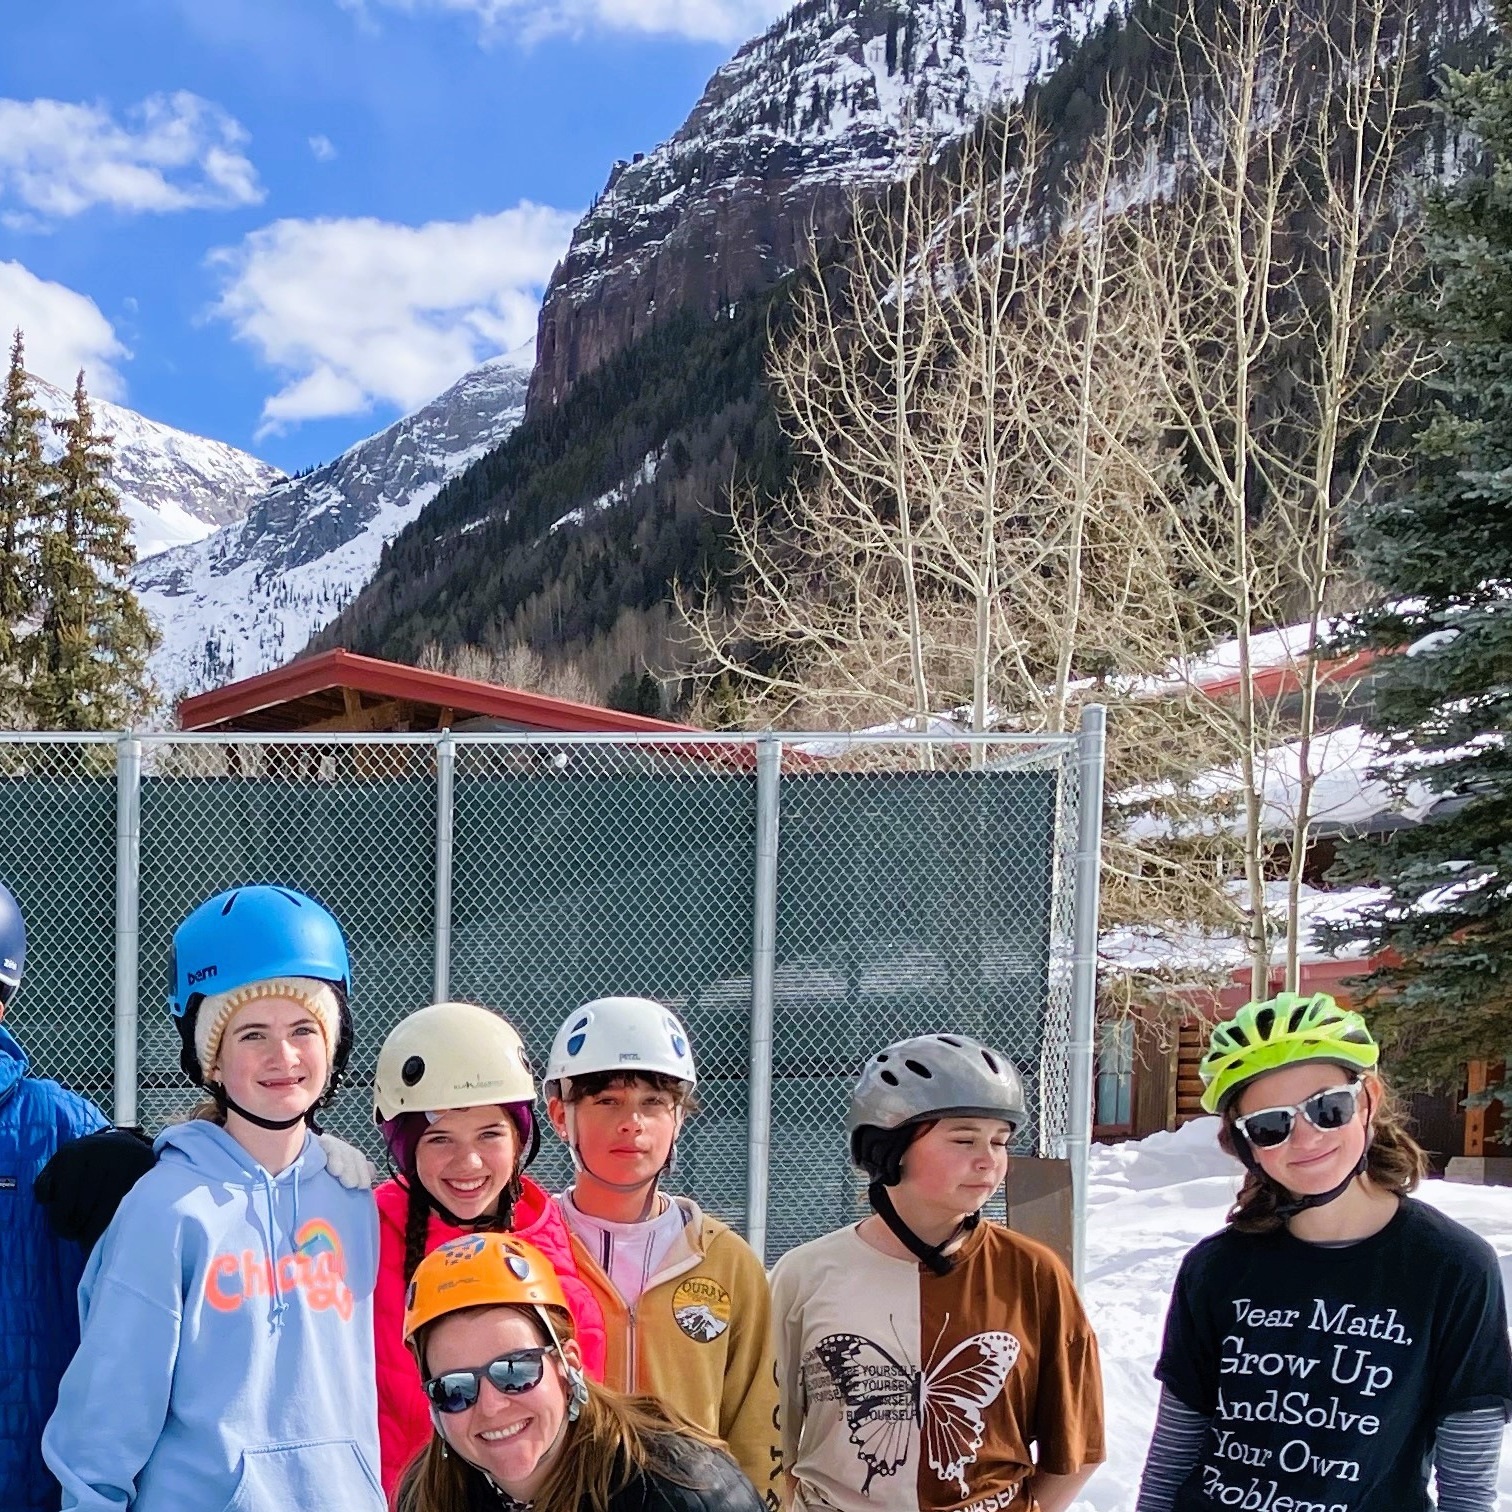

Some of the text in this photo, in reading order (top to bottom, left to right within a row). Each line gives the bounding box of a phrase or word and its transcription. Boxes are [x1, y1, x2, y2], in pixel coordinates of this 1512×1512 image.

[682, 1282, 729, 1303] OURAY
[1307, 1298, 1413, 1346] Math,
[863, 1379, 913, 1391] YOURSEL
[1331, 1344, 1393, 1397] Up
[1210, 1426, 1360, 1482] Your Own
